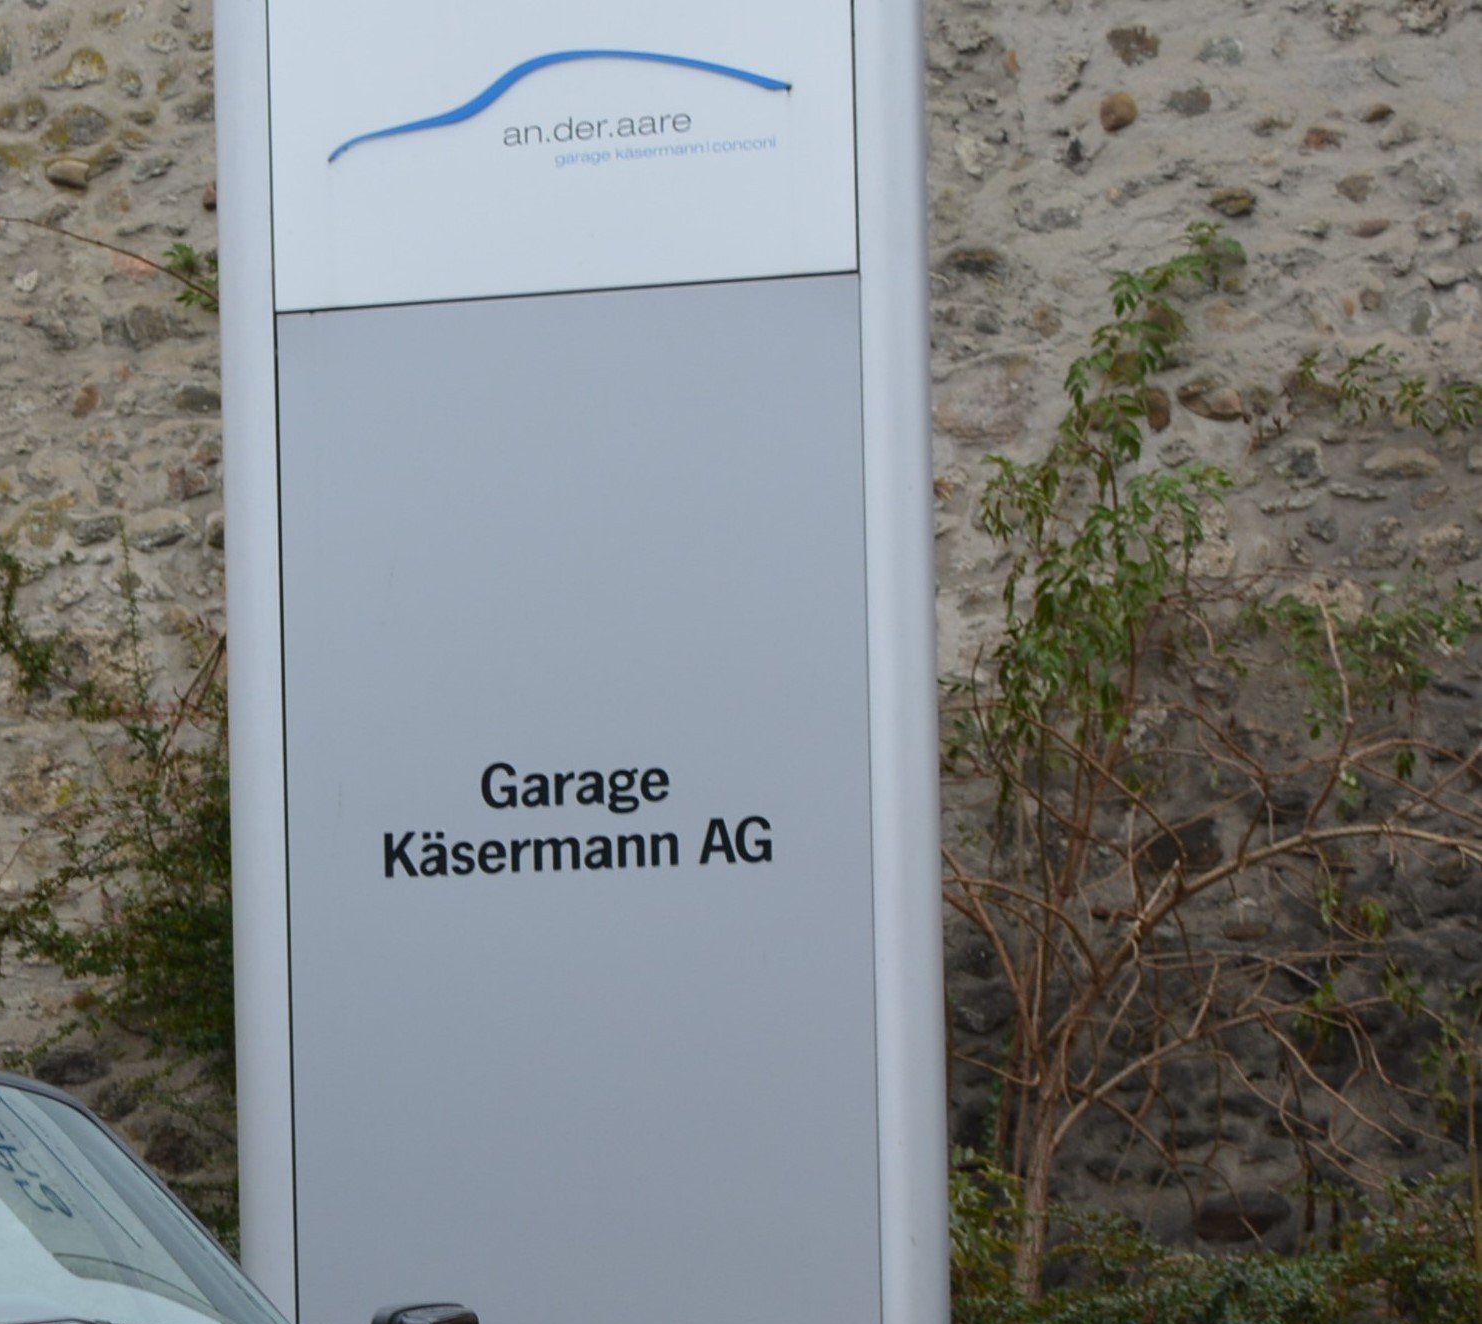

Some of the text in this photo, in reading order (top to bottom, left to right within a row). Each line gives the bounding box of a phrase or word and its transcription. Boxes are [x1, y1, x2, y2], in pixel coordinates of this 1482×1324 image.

[503, 112, 692, 147] an.der.aare
[555, 150, 611, 168] garage
[481, 762, 670, 814] Garage
[384, 816, 773, 878] Käsermann AG
